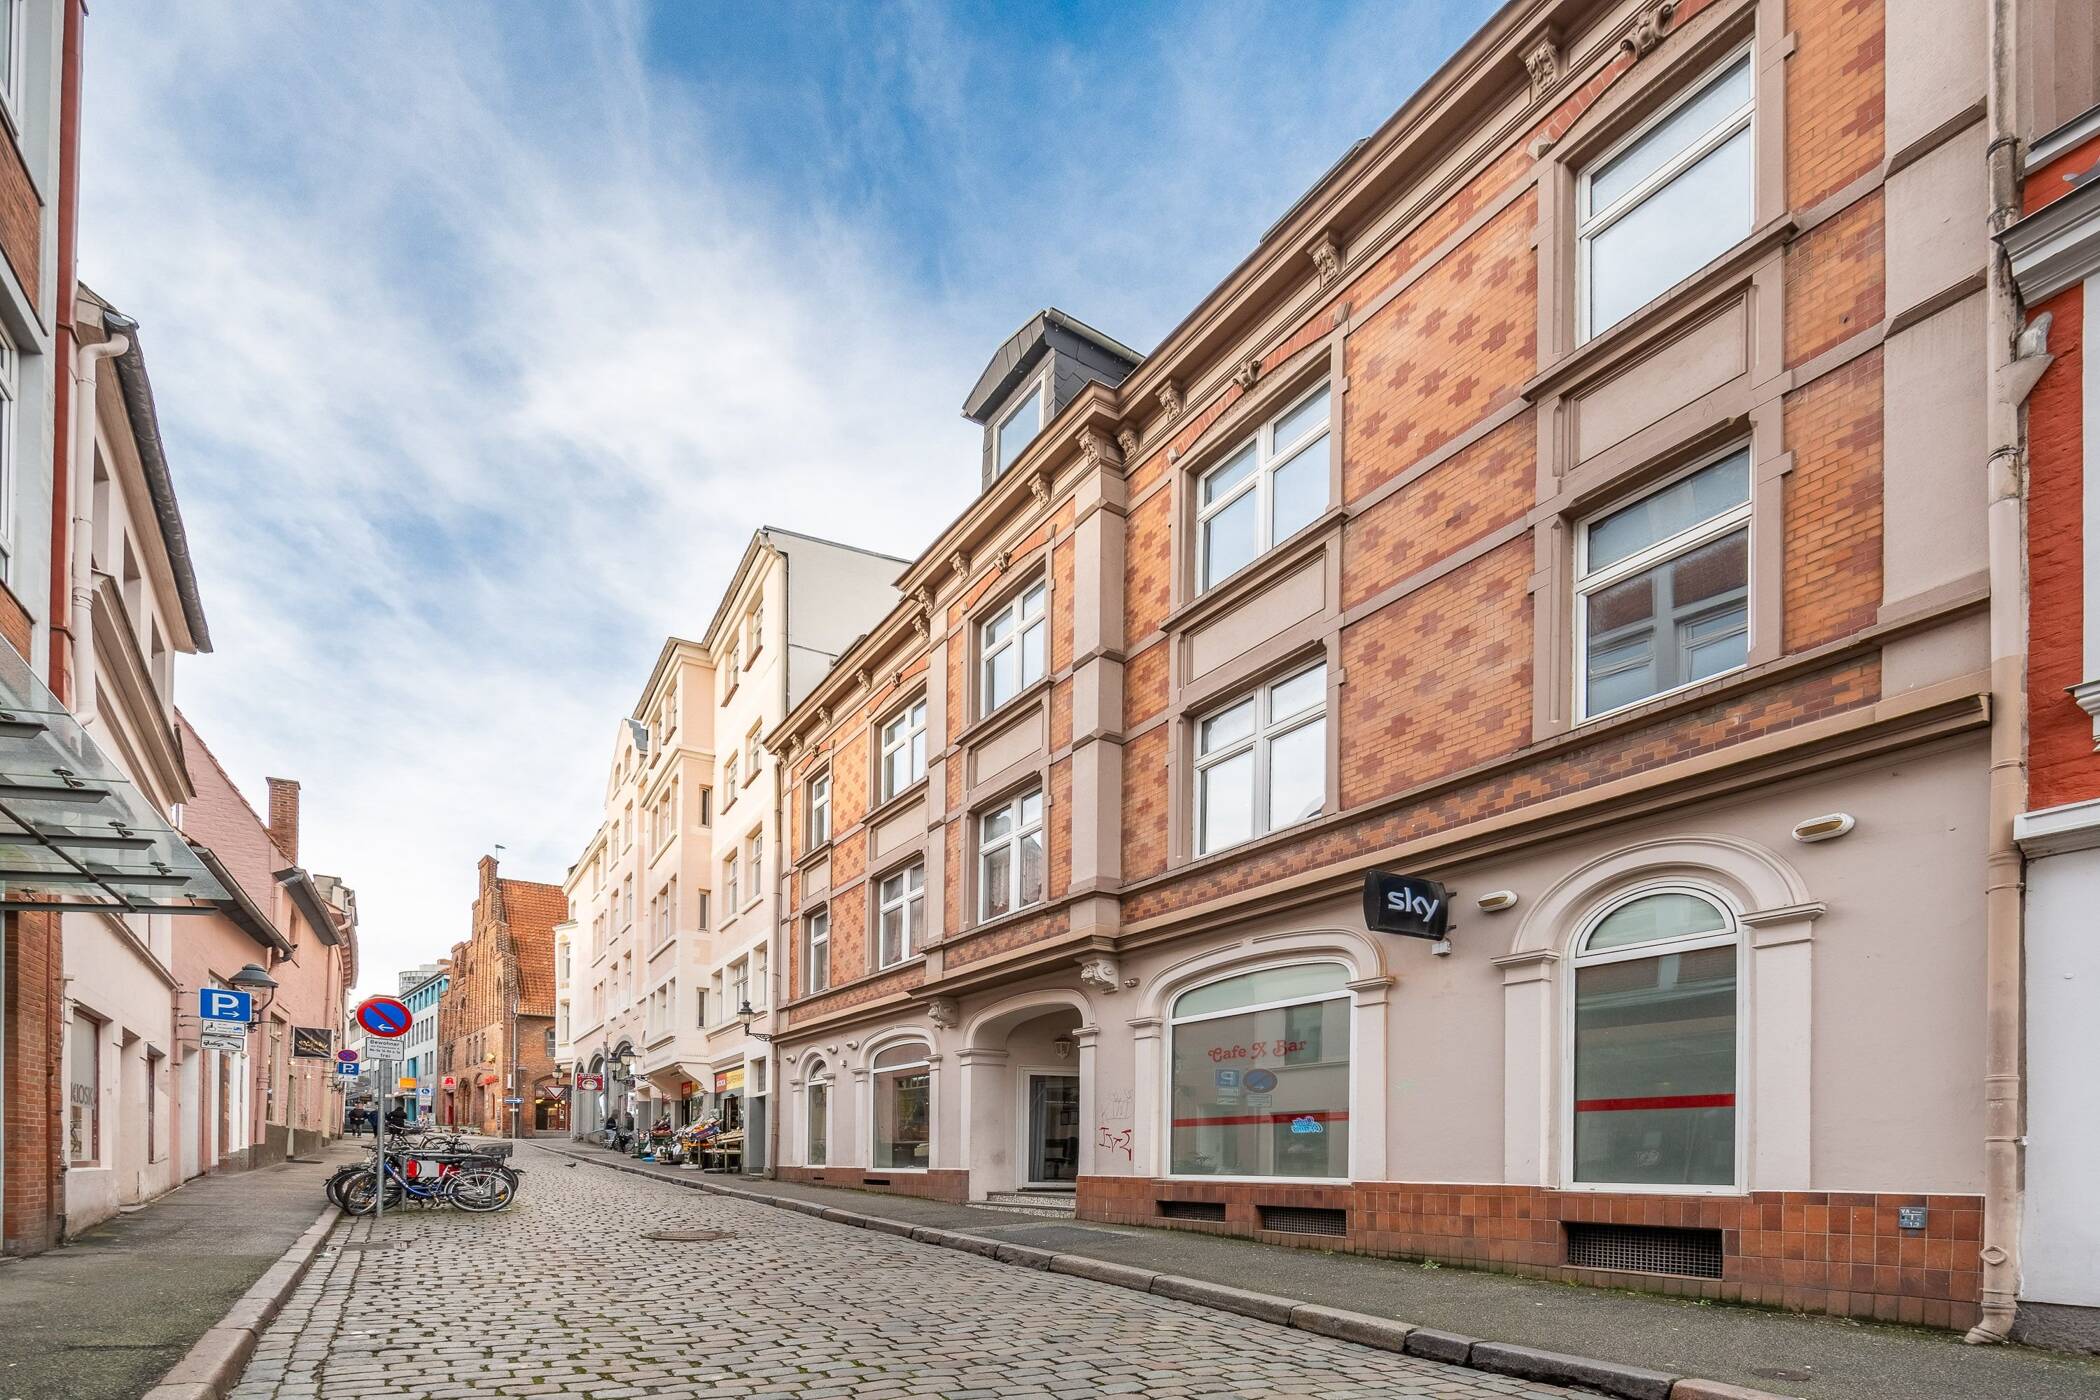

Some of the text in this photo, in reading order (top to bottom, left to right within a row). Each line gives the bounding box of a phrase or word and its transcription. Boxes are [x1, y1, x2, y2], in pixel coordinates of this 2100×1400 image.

[1388, 886, 1440, 922] sky
[211, 993, 239, 1016] P
[1207, 1045, 1248, 1063] Cafe
[1272, 1039, 1307, 1057] Bar
[342, 1063, 355, 1073] P
